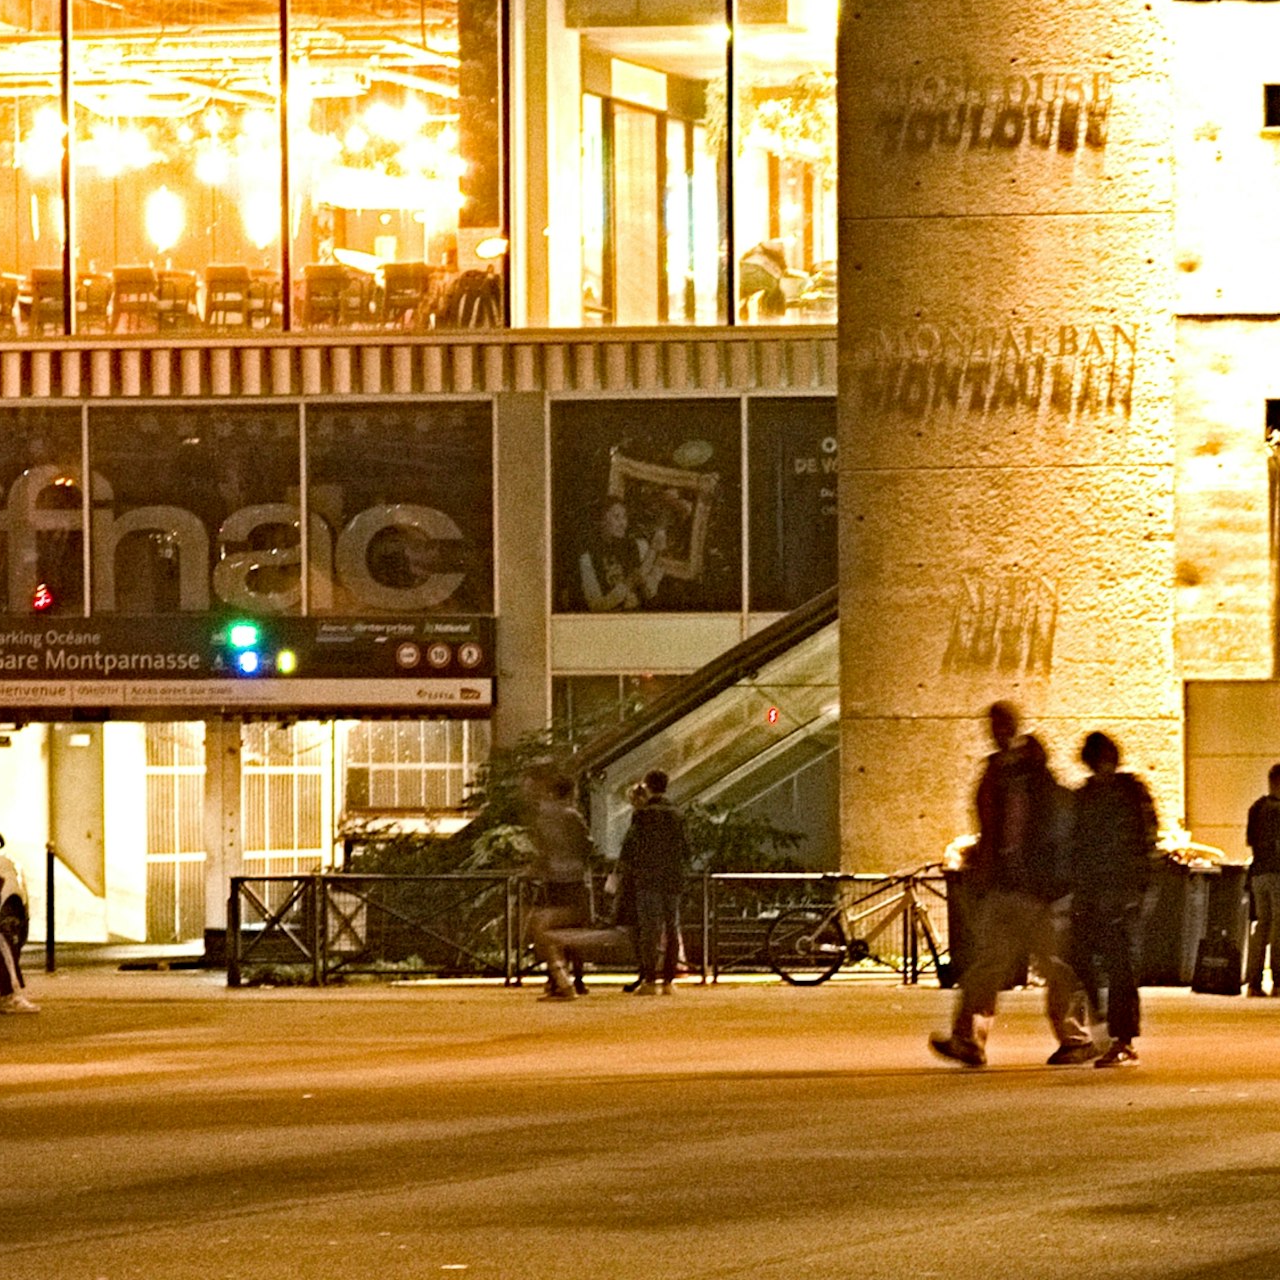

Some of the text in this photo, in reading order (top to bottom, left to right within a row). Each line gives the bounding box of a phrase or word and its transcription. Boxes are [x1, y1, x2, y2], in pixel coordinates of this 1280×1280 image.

[874, 71, 1112, 152] TOULOUSE
[858, 322, 1140, 415] MONTAUBAN
[45, 648, 200, 674] Montparnasse
[46, 629, 101, 646] Océane
